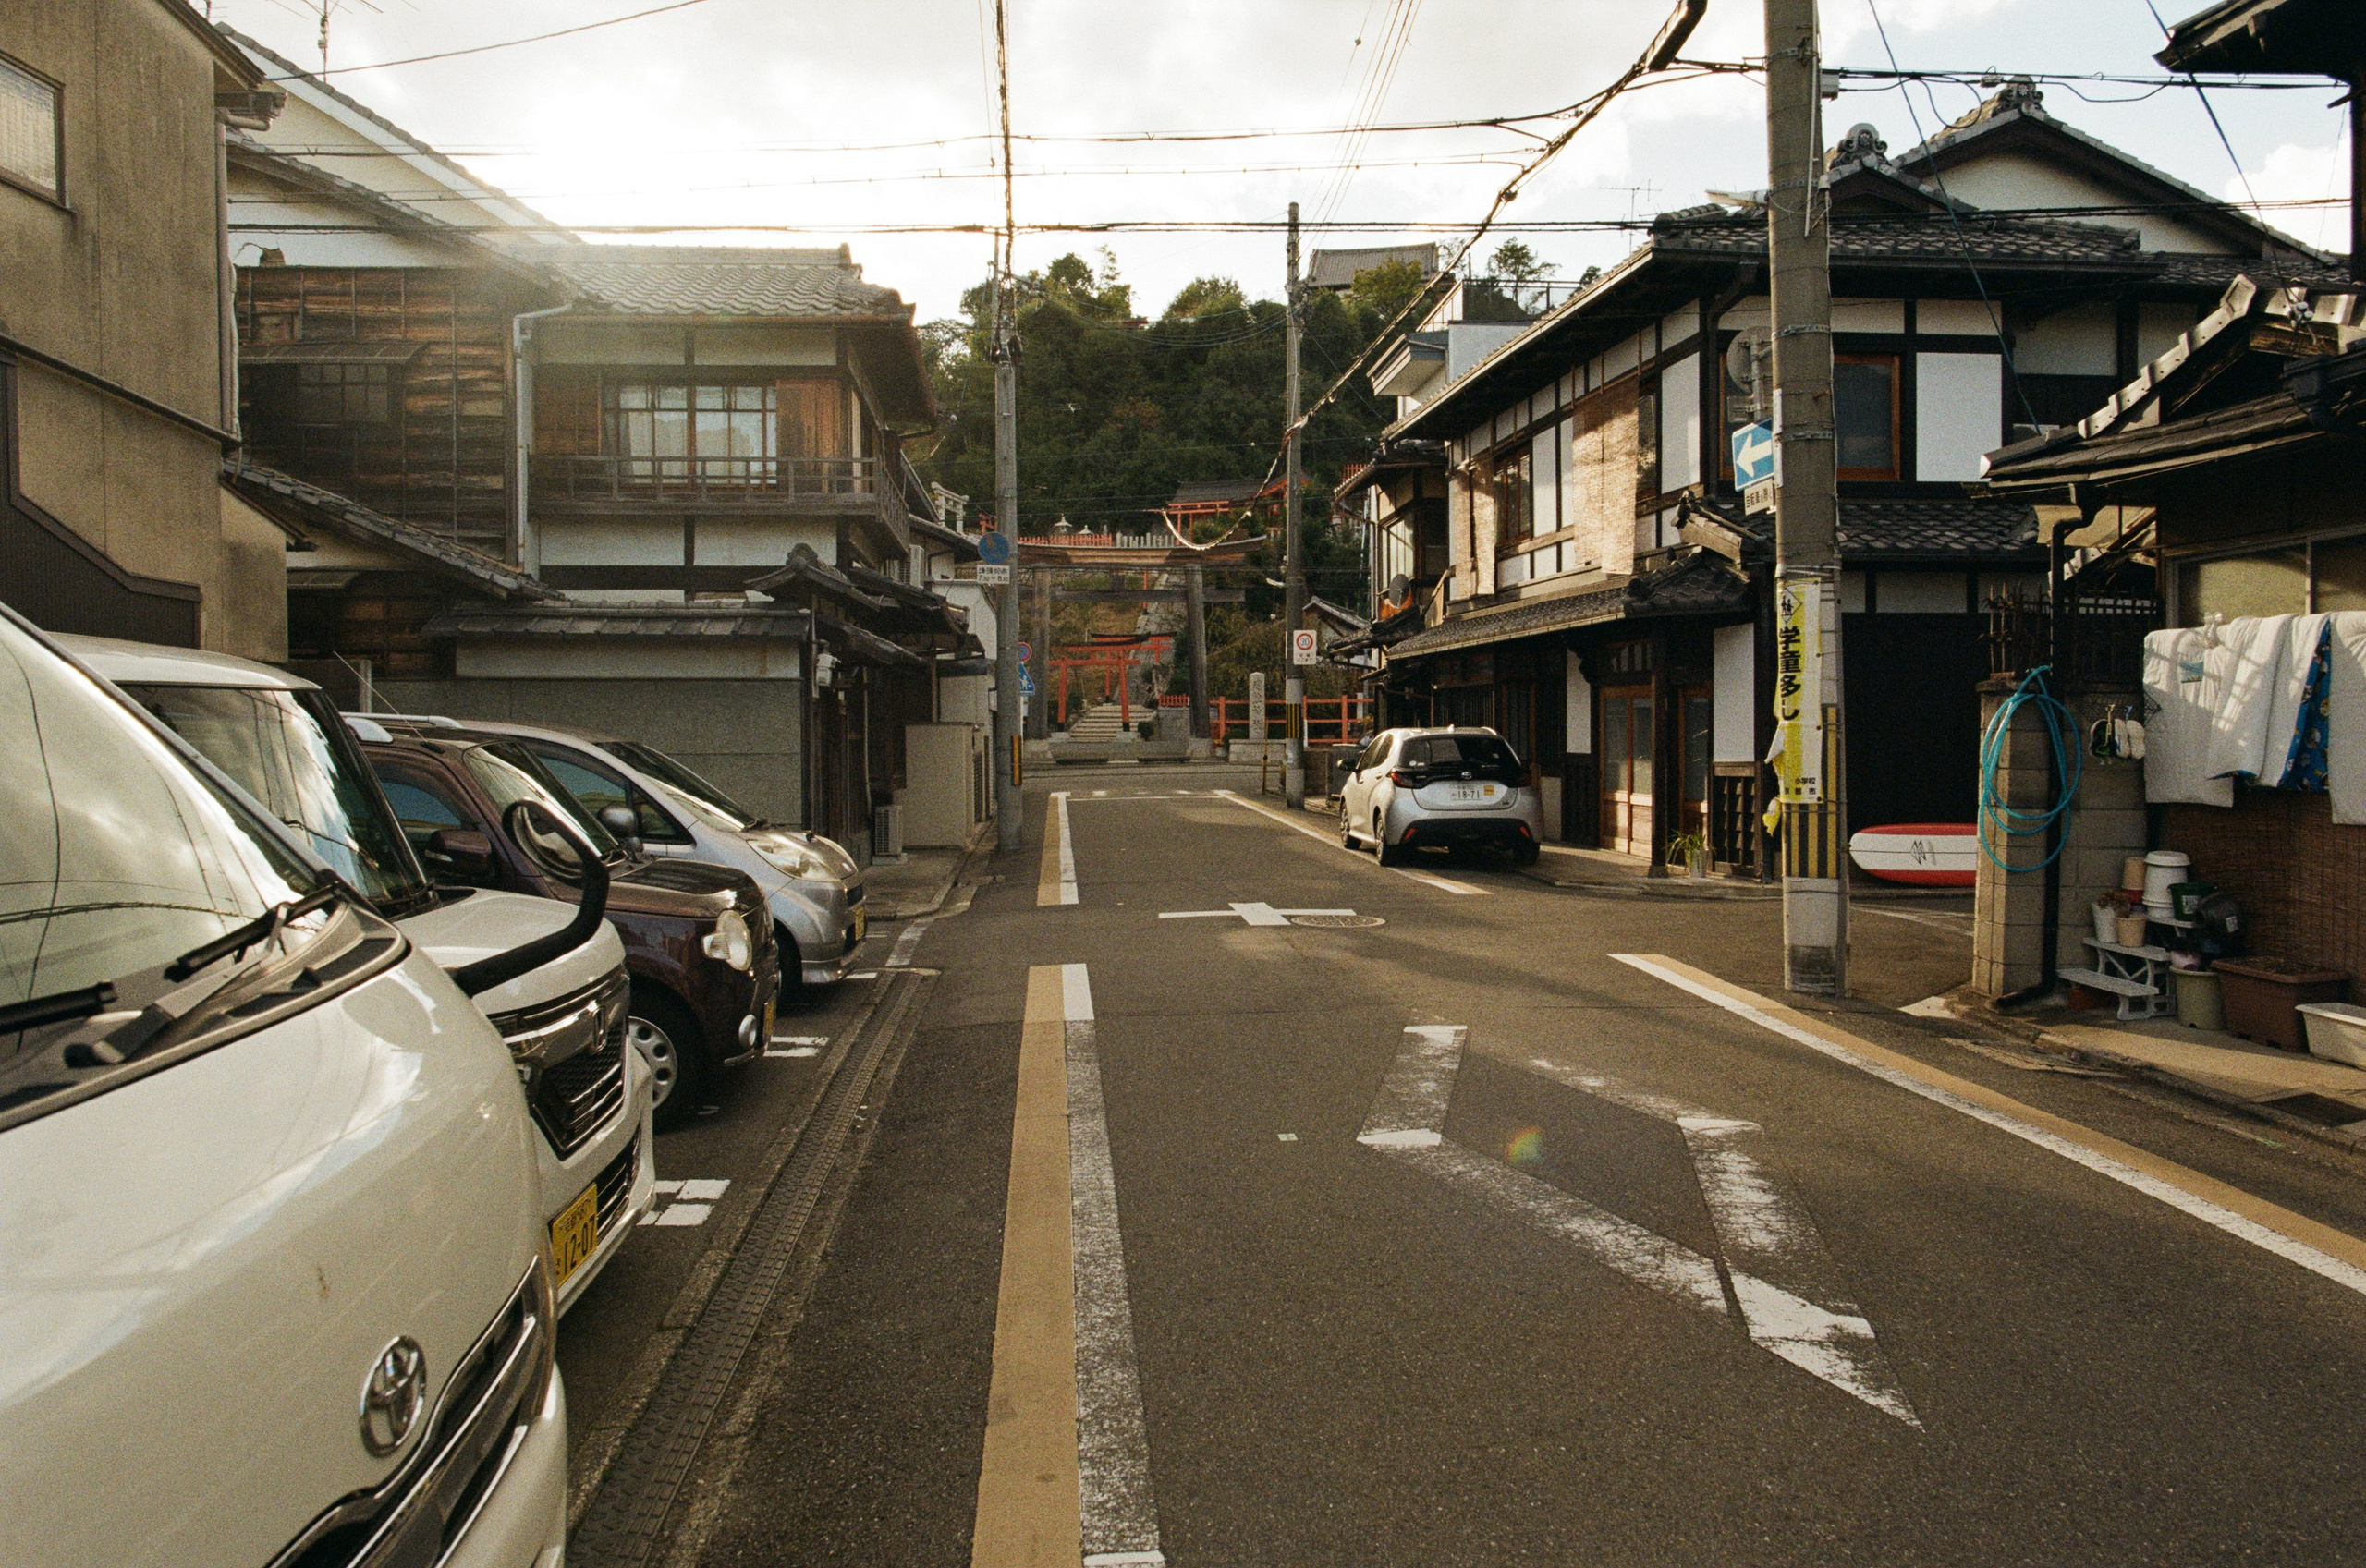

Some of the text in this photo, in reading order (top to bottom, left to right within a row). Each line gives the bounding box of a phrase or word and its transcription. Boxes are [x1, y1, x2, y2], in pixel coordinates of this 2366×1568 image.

[1299, 637, 1311, 647] 30
[1779, 626, 1801, 721] 学童多し
[1795, 777, 1816, 785] 小学校
[1457, 790, 1480, 799] 18-71
[564, 1214, 596, 1276] 12-07
